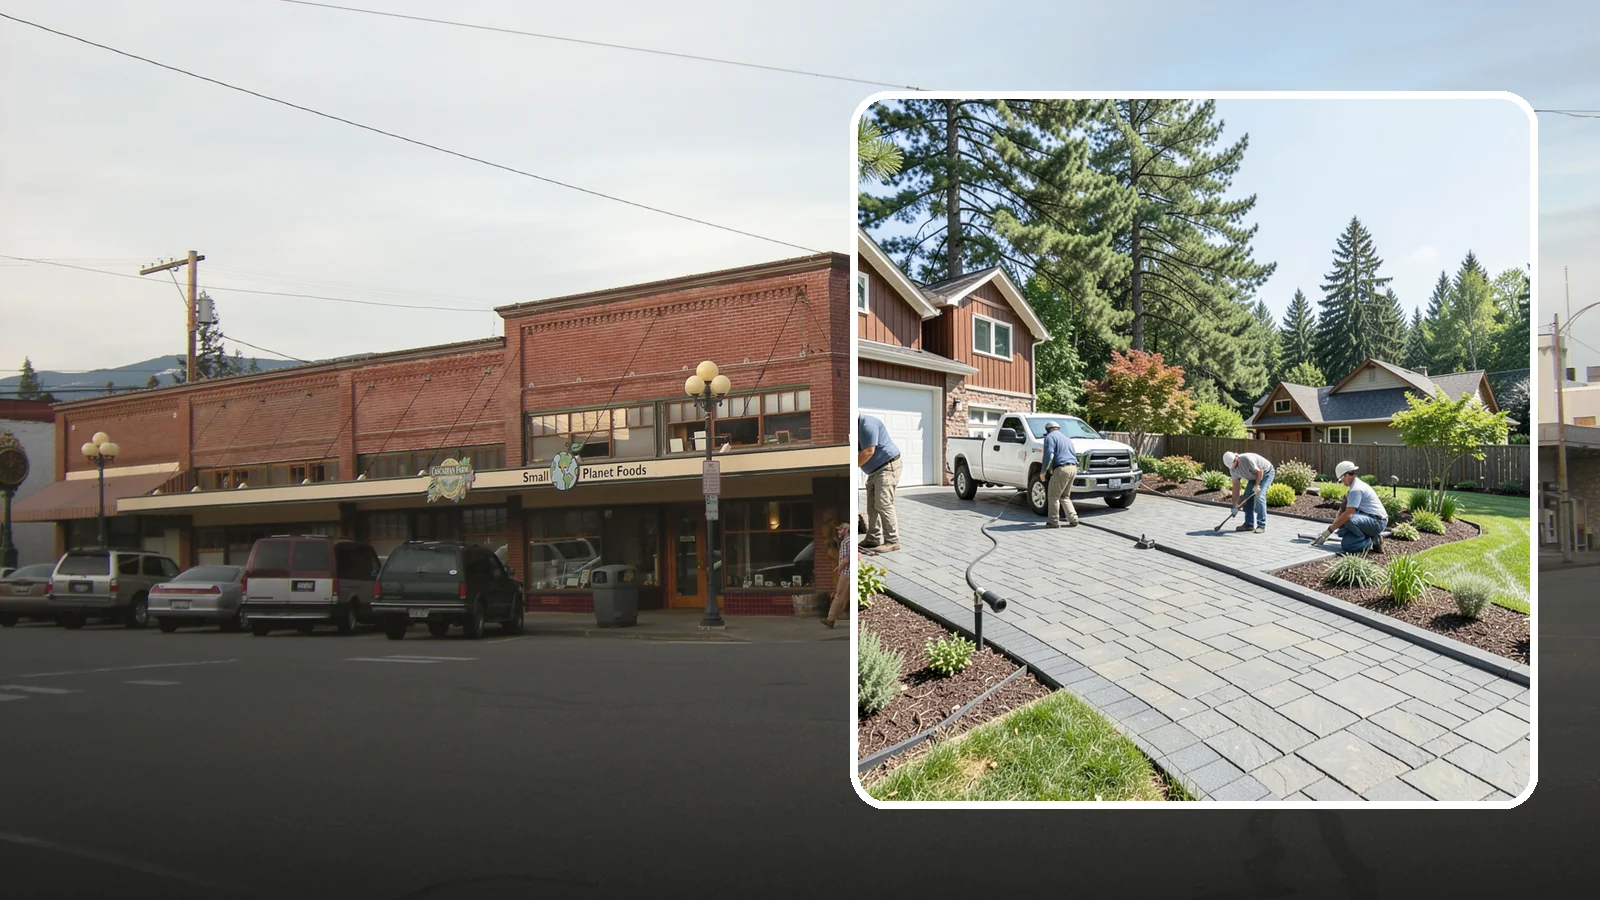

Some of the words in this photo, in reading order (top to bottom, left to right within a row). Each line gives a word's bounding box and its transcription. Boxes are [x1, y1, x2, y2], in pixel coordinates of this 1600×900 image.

[431, 466, 456, 476] CASCADIAN
[456, 465, 469, 474] FARM
[523, 471, 549, 483] Small
[583, 467, 614, 479] Planet
[617, 464, 647, 477] Foods
